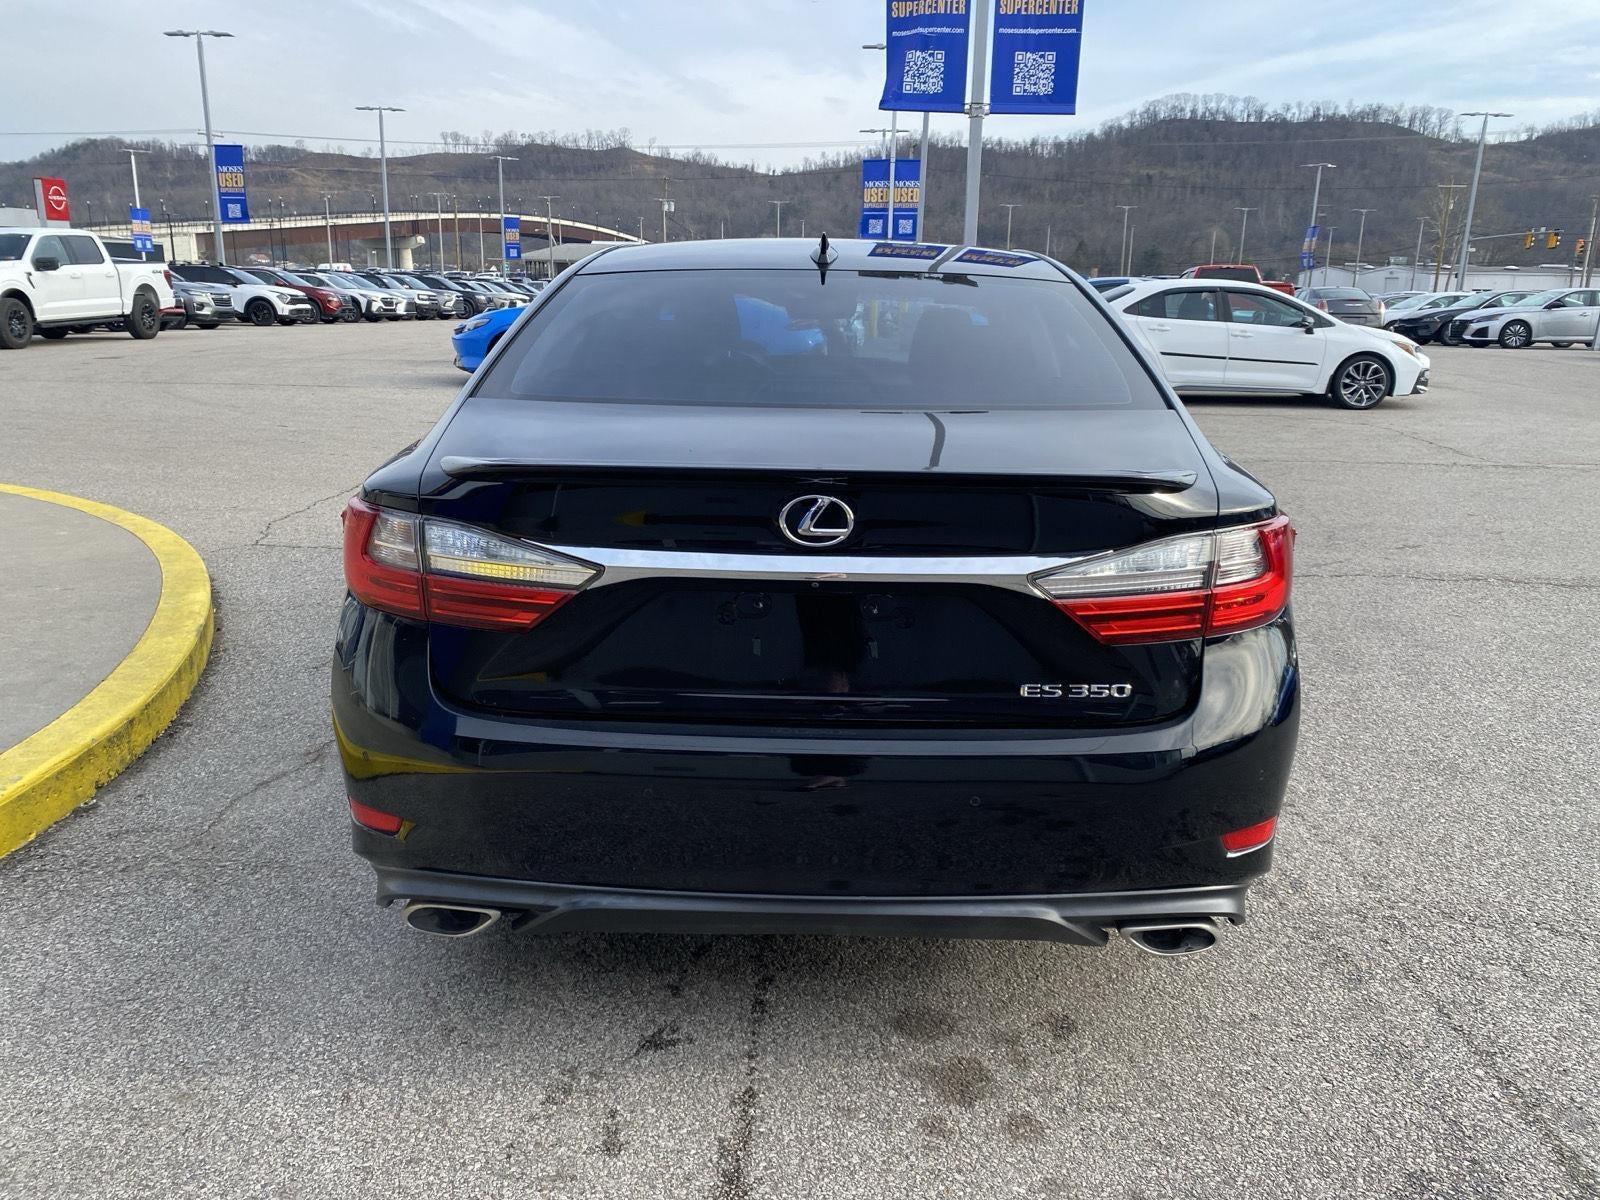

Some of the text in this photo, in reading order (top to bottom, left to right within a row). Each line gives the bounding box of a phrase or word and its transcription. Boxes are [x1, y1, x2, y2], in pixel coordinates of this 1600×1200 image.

[891, 0, 966, 18] SUPERCENTER
[999, 0, 1079, 15] SUPERCENTER
[892, 26, 965, 37] mosesusedsupercenter.com
[998, 27, 1077, 35] mosesusedsupercenter.com
[219, 173, 244, 188] USED
[894, 188, 920, 203] USED
[1020, 683, 1132, 698] ES 350
